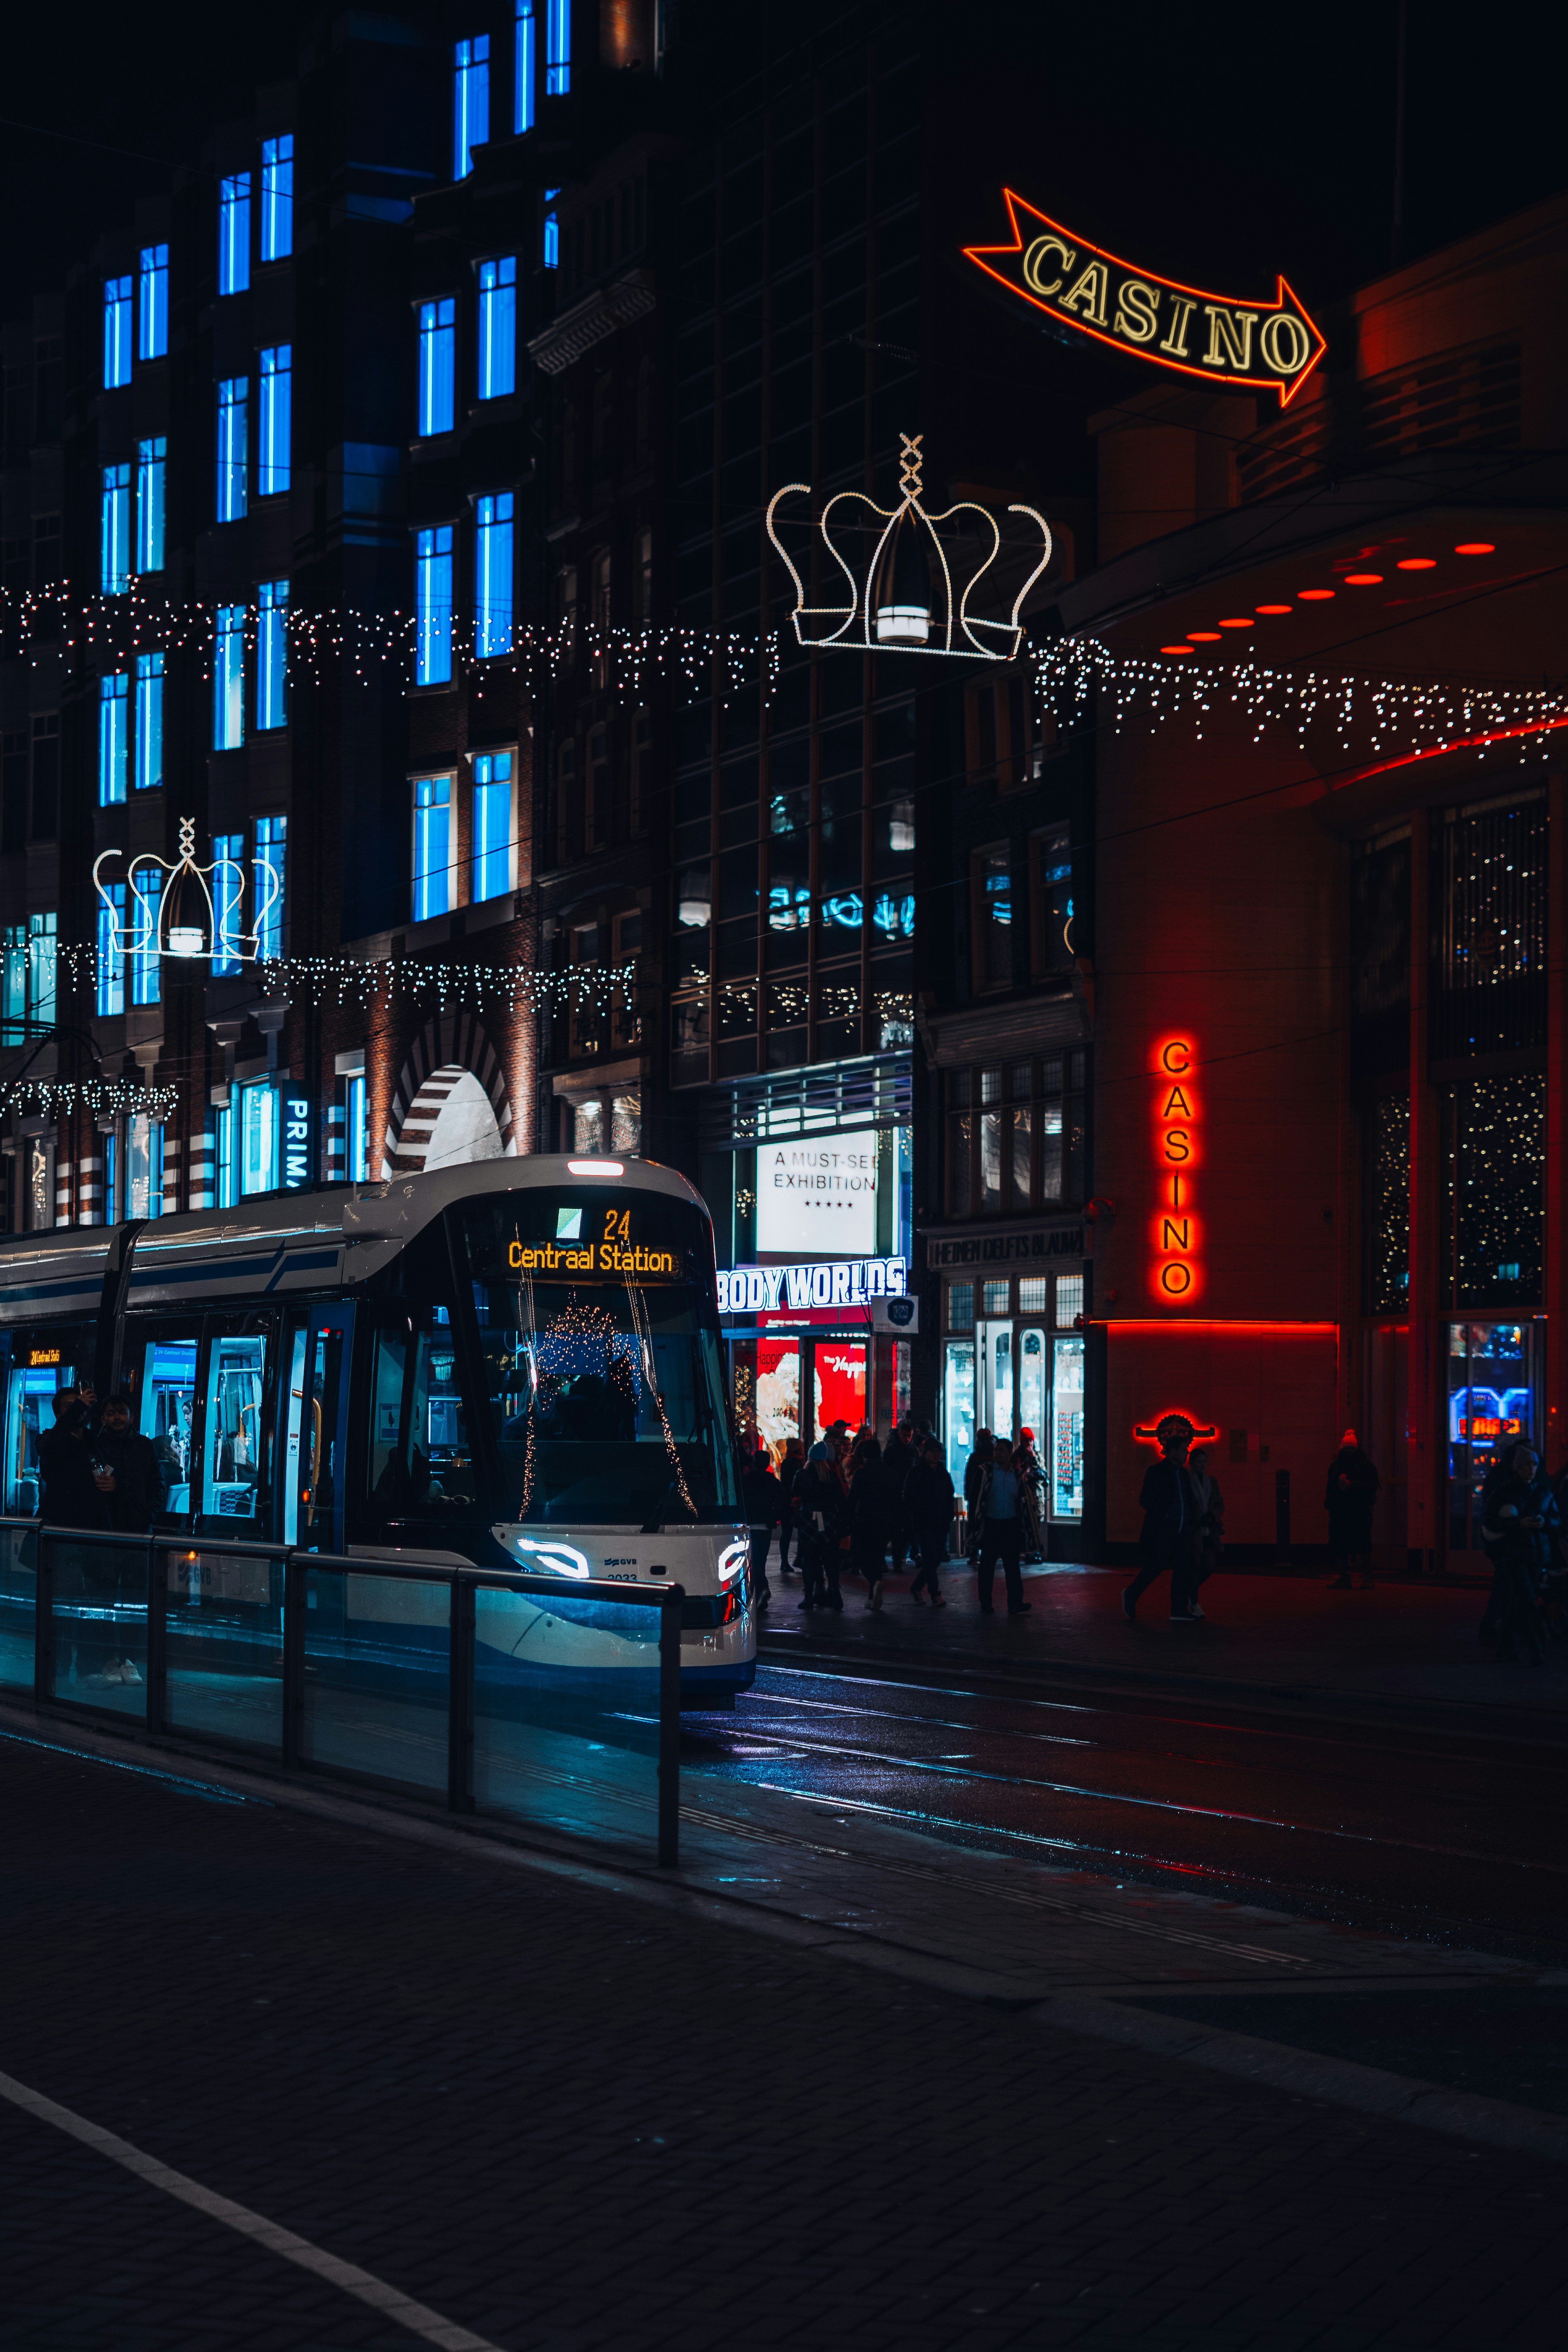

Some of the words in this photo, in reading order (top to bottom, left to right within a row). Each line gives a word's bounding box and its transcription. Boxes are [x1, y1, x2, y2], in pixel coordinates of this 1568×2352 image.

[1023, 234, 1310, 374] CASINO
[775, 1152, 785, 1166] A
[792, 1152, 879, 1170] MUST-SEE
[1162, 1042, 1191, 1293] CASINO
[774, 1174, 875, 1191] EXHIBITION
[604, 1209, 630, 1240] 24
[509, 1241, 594, 1270] Centraal
[600, 1244, 672, 1272] Station
[935, 1240, 979, 1265] HEINEN
[983, 1235, 1029, 1260] DELFTS
[1032, 1231, 1079, 1256] BLAUW
[716, 1269, 784, 1312] BODY
[786, 1258, 905, 1308] WORLDS
[31, 1351, 37, 1365] 24
[194, 1566, 211, 1585] GVB
